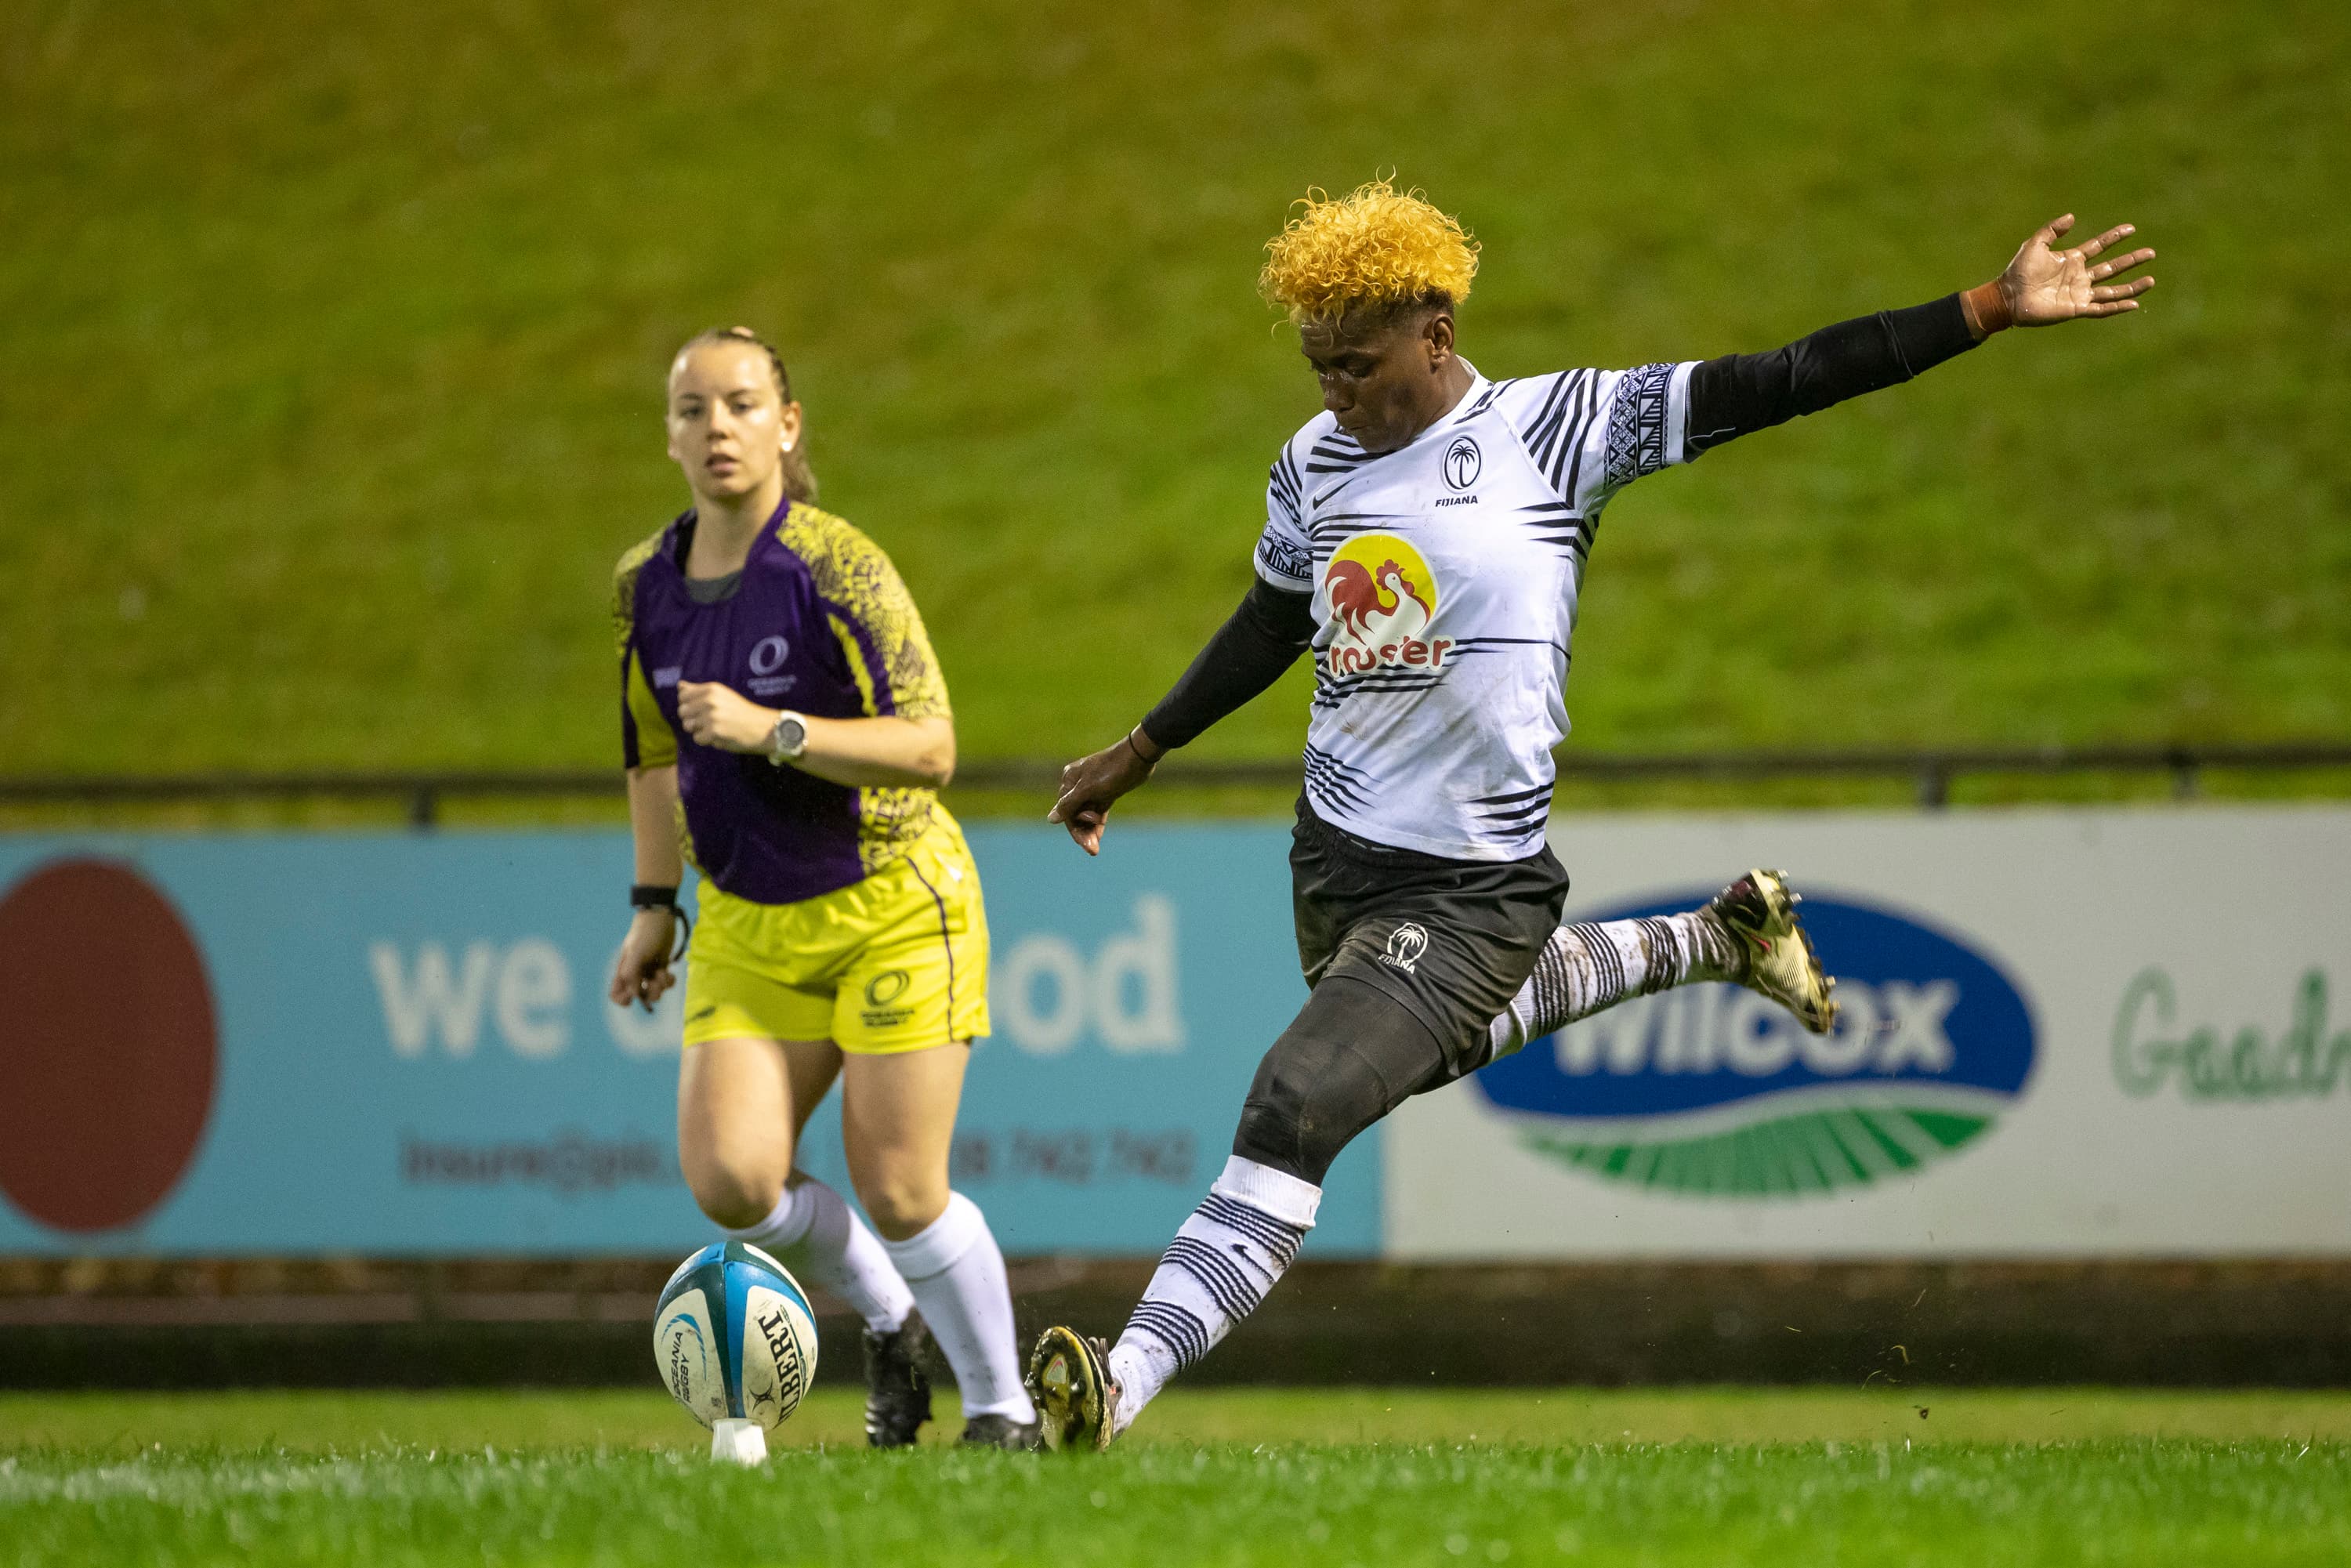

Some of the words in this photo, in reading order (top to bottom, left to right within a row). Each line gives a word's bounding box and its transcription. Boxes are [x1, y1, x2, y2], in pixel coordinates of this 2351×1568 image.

[1435, 494, 1479, 508] FIJIANA
[368, 936, 572, 1059] we
[680, 1353, 691, 1403] RUGBY
[758, 1309, 801, 1430] ILBERT
